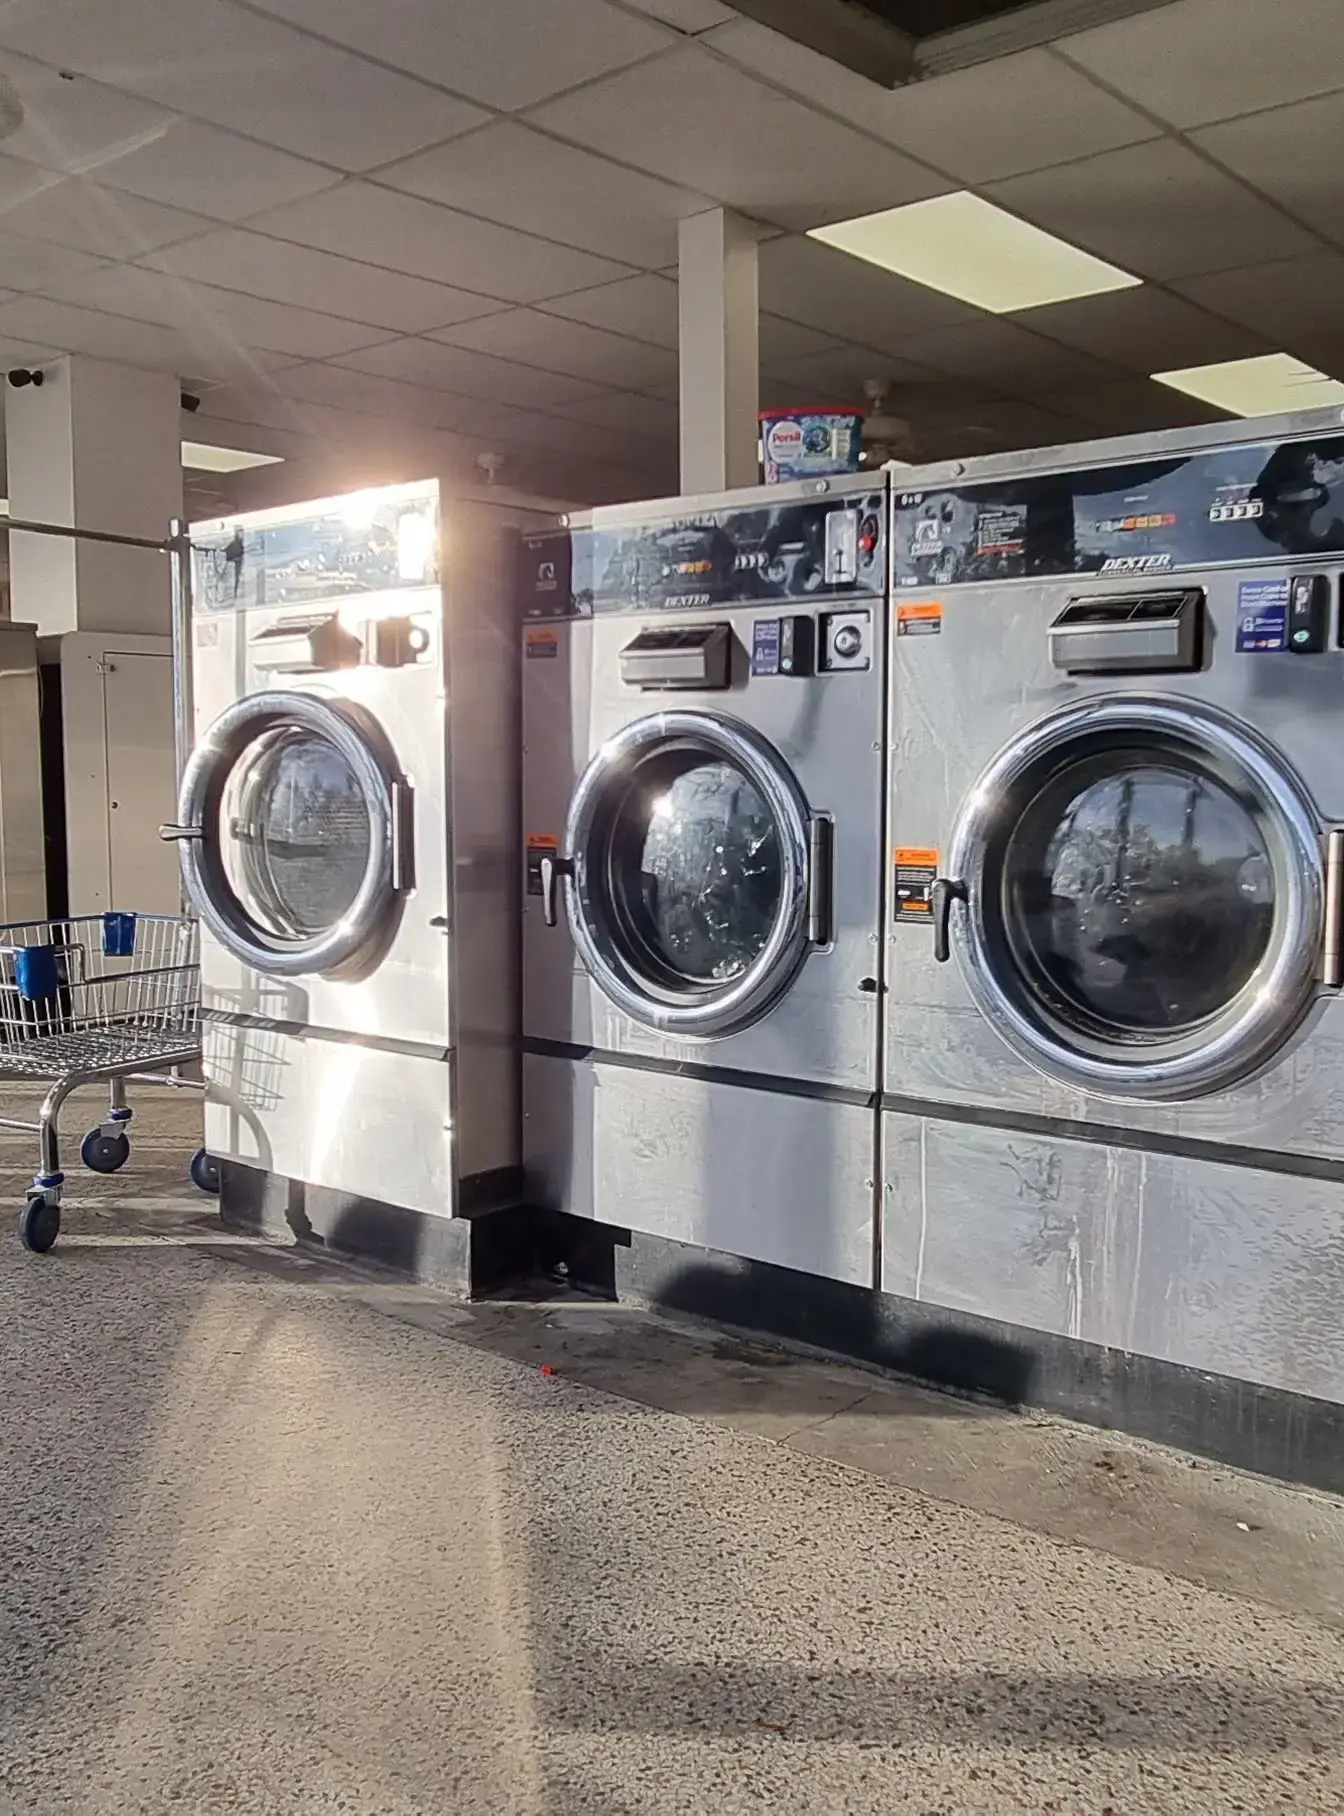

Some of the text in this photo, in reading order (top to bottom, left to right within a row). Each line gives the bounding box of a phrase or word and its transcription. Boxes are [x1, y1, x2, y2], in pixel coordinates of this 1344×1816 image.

[772, 431, 801, 442] Persil
[1101, 553, 1172, 571] DEXTER
[664, 593, 711, 608] DEXTER
